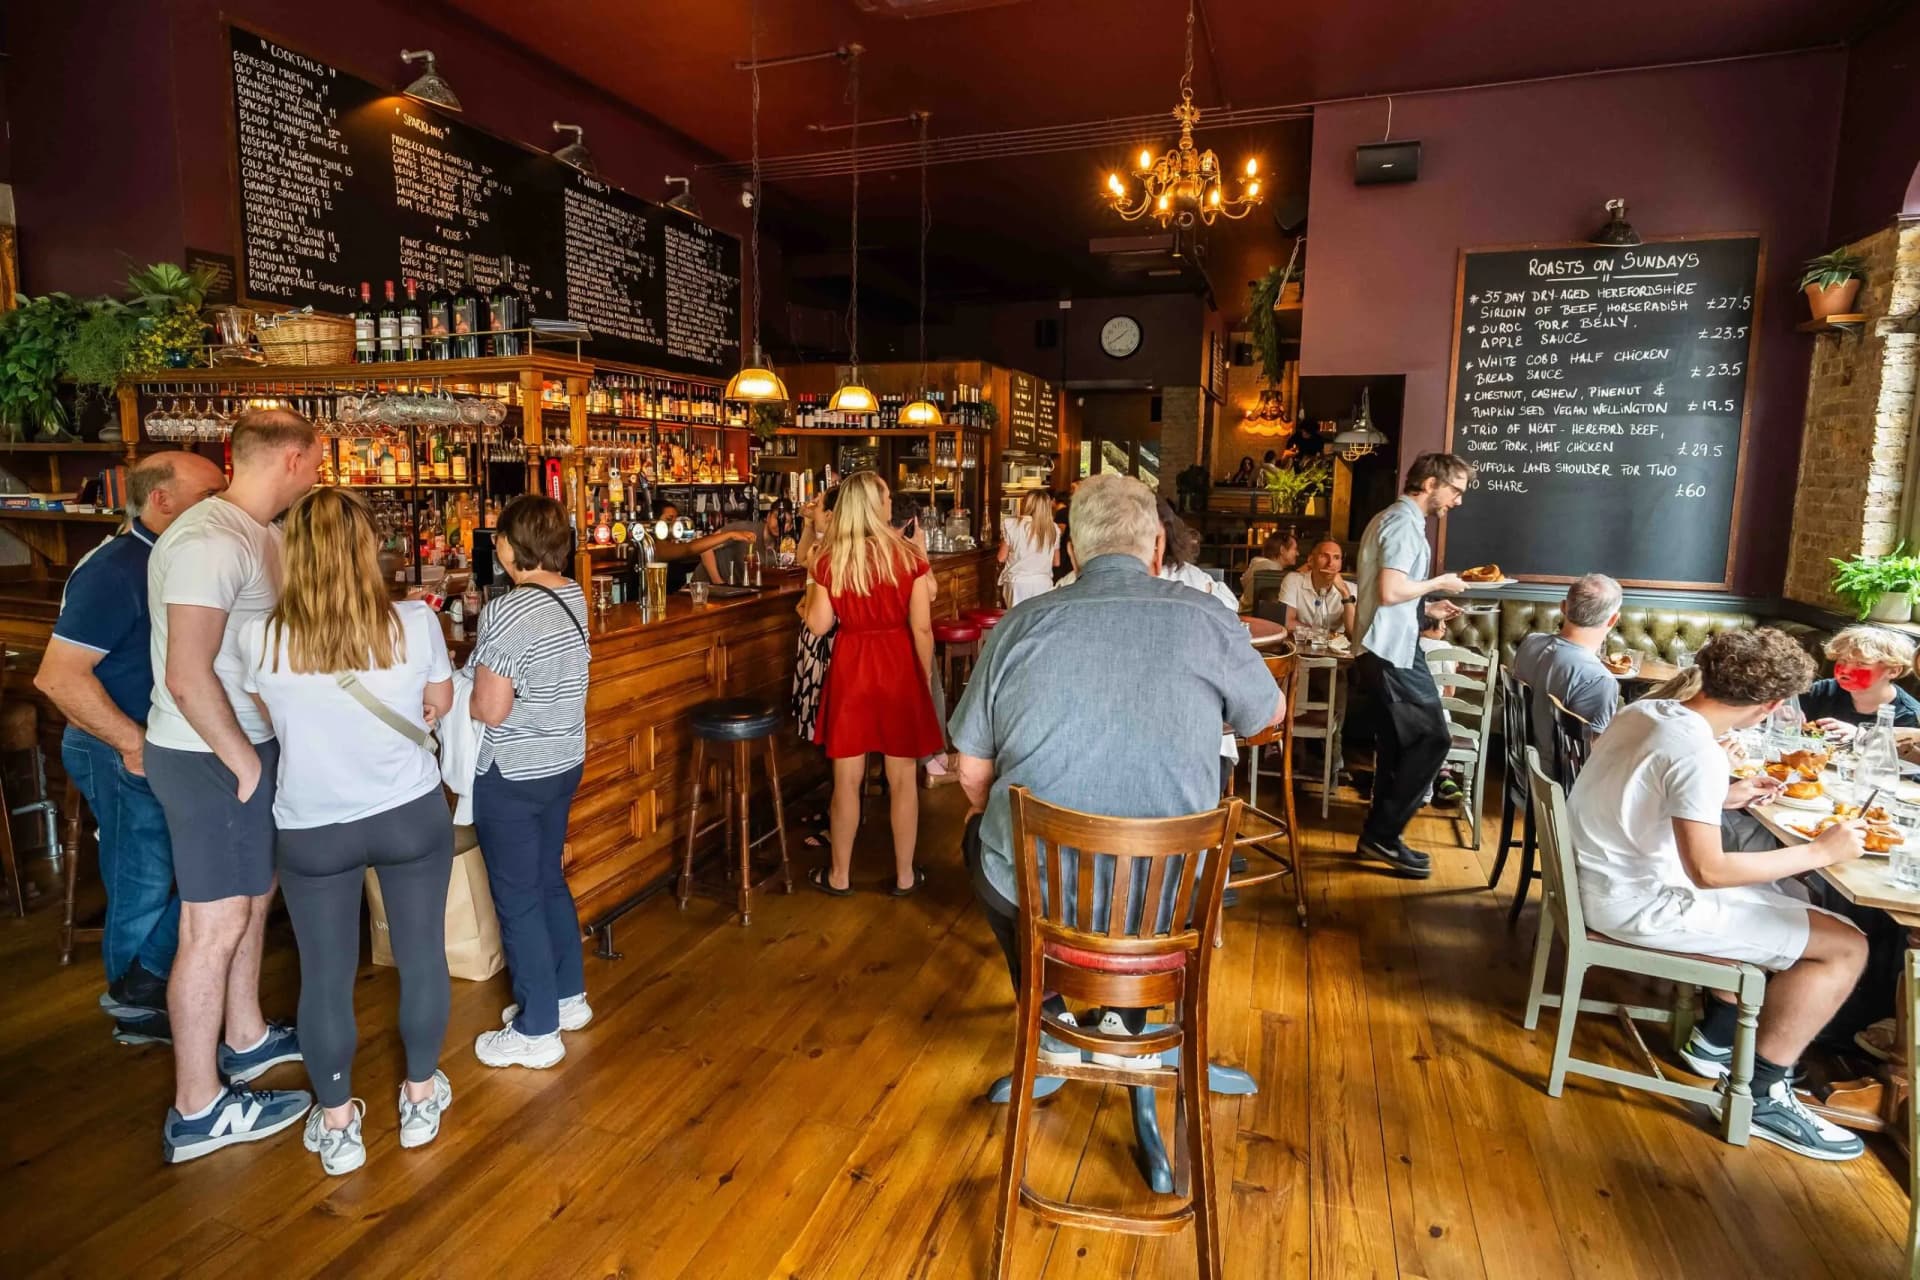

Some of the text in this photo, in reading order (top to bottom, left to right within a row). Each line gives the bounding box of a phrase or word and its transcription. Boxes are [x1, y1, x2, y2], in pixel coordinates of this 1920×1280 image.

[271, 44, 324, 76] COCKTAILS
[233, 50, 329, 96] ESPRESSO MARTINI 11
[235, 62, 252, 76] OLD
[256, 71, 304, 95] FASHIONED
[236, 74, 272, 94] ORANGE
[329, 107, 336, 120] 11
[238, 84, 280, 109] RHUBARB
[284, 102, 315, 121] MARTINI
[238, 96, 270, 115] SPICED
[273, 109, 322, 134] MANHATTAN
[403, 113, 444, 140] SPARKLING
[240, 108, 269, 127] BLOOD
[273, 120, 309, 140] ORANGE
[310, 134, 338, 151] GIMLET
[340, 144, 349, 155] 12
[240, 121, 306, 151] FRENCH 75 12
[240, 134, 286, 158] ROSEMARY
[288, 149, 321, 166] NEGRONI
[392, 134, 425, 154] PROSECCO
[241, 145, 330, 180] VESPER MARTINI 12
[241, 156, 344, 192] COLD BREW NEGRONI 12
[242, 167, 278, 184] CORPSE
[244, 190, 320, 220] COSMOPOLITAN 11
[277, 187, 320, 207] SBAGLIATO
[324, 200, 334, 211] 12
[396, 196, 413, 210] DOM
[246, 202, 306, 226] MARGARITA 11
[247, 212, 300, 234] DISARONNO
[328, 232, 335, 242] 11
[247, 222, 282, 240] SACRED
[287, 232, 324, 249] NEGRONI
[248, 235, 277, 250] COMTE
[400, 236, 422, 249] PINOT
[248, 245, 285, 264] JASMINA
[1529, 252, 1700, 276] ROASTS ON SUNDAYS
[249, 258, 277, 272] BLOOD
[280, 264, 301, 280] MARY
[306, 268, 314, 280] 11
[424, 262, 437, 273] DE
[249, 268, 270, 282] PINK
[270, 274, 318, 290] GRAPEFRUIT
[319, 282, 346, 296] GIMLET
[349, 288, 358, 298] 12
[250, 280, 293, 296] ROSITA 12
[1481, 281, 1697, 304] 35 DAY DRY-AGED HEREFORDSHIRE
[1480, 305, 1526, 319] SIRLOIN
[1535, 306, 1552, 316] OF
[1607, 300, 1688, 313] HORSERADISH
[1706, 296, 1751, 310] £27.5
[1480, 322, 1522, 334] DUROC
[1535, 320, 1569, 331] PORK
[1481, 326, 1748, 349] APPLE SAUCE £23.5
[1478, 348, 1670, 368] WHITE COBB HALF CHICKEN
[1475, 373, 1514, 386] BREAD
[1526, 368, 1565, 380] SAUCE
[1474, 390, 1526, 402] CHESTNUT,
[1588, 386, 1642, 398] PINENUT
[1472, 400, 1734, 418] PUMPKIN SEED VEGAN WELLINGTON £19.5
[1471, 424, 1498, 436] TRIO
[1506, 424, 1520, 434] OF
[1528, 423, 1557, 436] MEAT
[1572, 424, 1624, 436] HEREFORD
[1536, 441, 1560, 452] HALF
[1566, 440, 1614, 453] CHICKEN
[1678, 442, 1724, 457] £29.5
[1472, 460, 1676, 476] SUFFOLK LAMB SHOULDER FOR TWO
[1487, 480, 1528, 493] SHARE
[1674, 483, 1706, 498] £60
